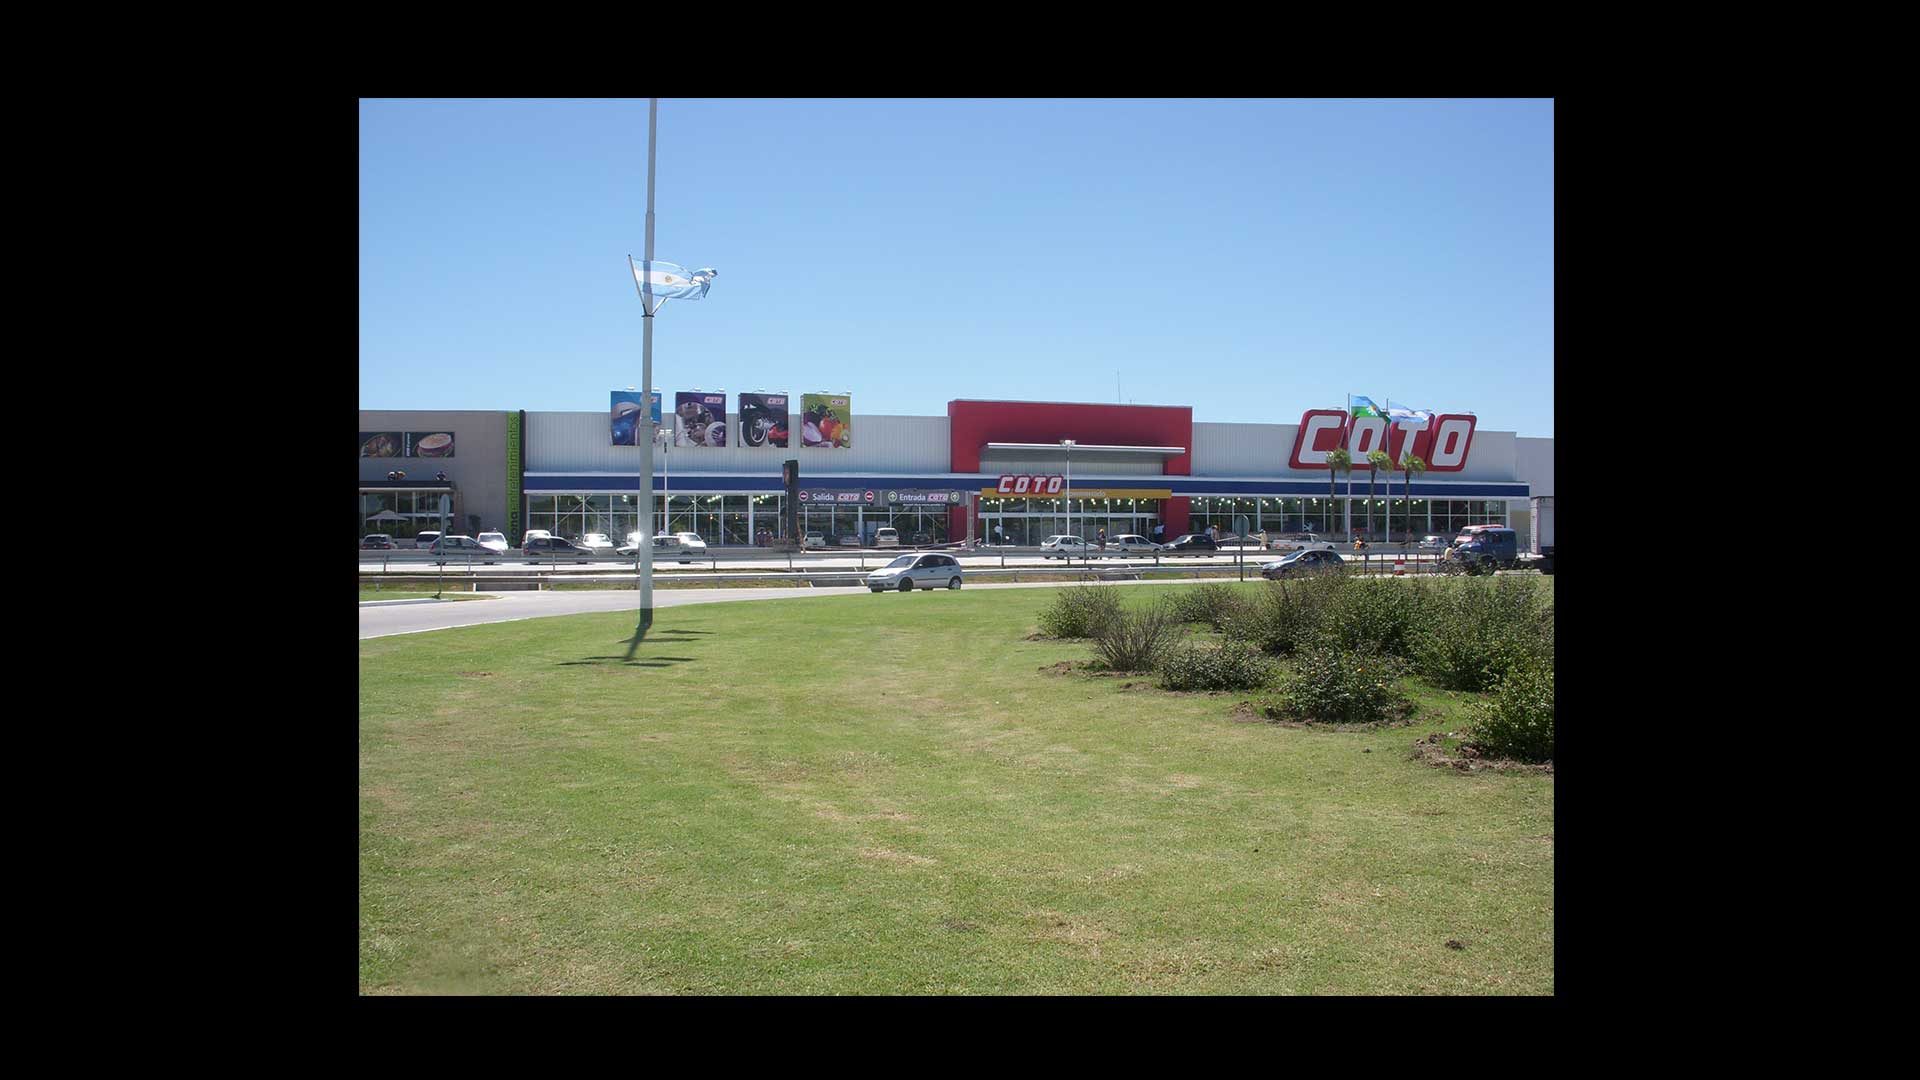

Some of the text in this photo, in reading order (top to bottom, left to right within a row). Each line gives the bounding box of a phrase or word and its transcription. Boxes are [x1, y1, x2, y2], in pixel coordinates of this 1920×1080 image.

[1298, 415, 1472, 466] COTO
[998, 476, 1062, 493] COTO
[813, 493, 834, 501] Salida
[899, 493, 926, 501] Entrada
